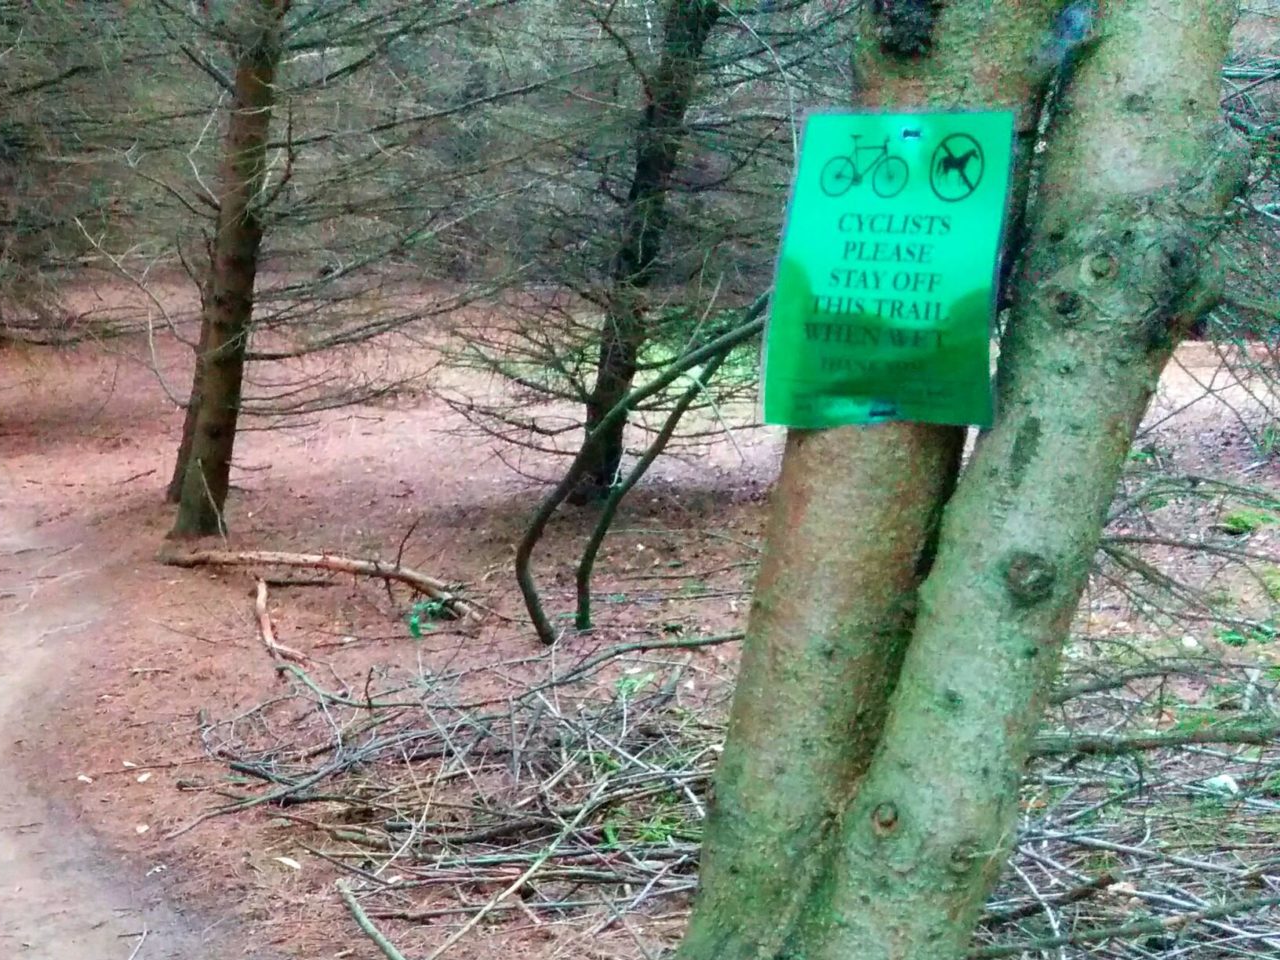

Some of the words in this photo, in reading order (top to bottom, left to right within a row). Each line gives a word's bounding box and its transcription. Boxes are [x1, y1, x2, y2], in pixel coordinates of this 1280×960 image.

[838, 213, 952, 236] CYCLISTS
[842, 240, 934, 264] PLEASE
[829, 268, 888, 290] STAY
[892, 271, 942, 293] OFF
[812, 295, 866, 316] THIS
[873, 297, 951, 321] TRAIL
[804, 322, 883, 346] WHEN
[889, 328, 951, 349] WET
